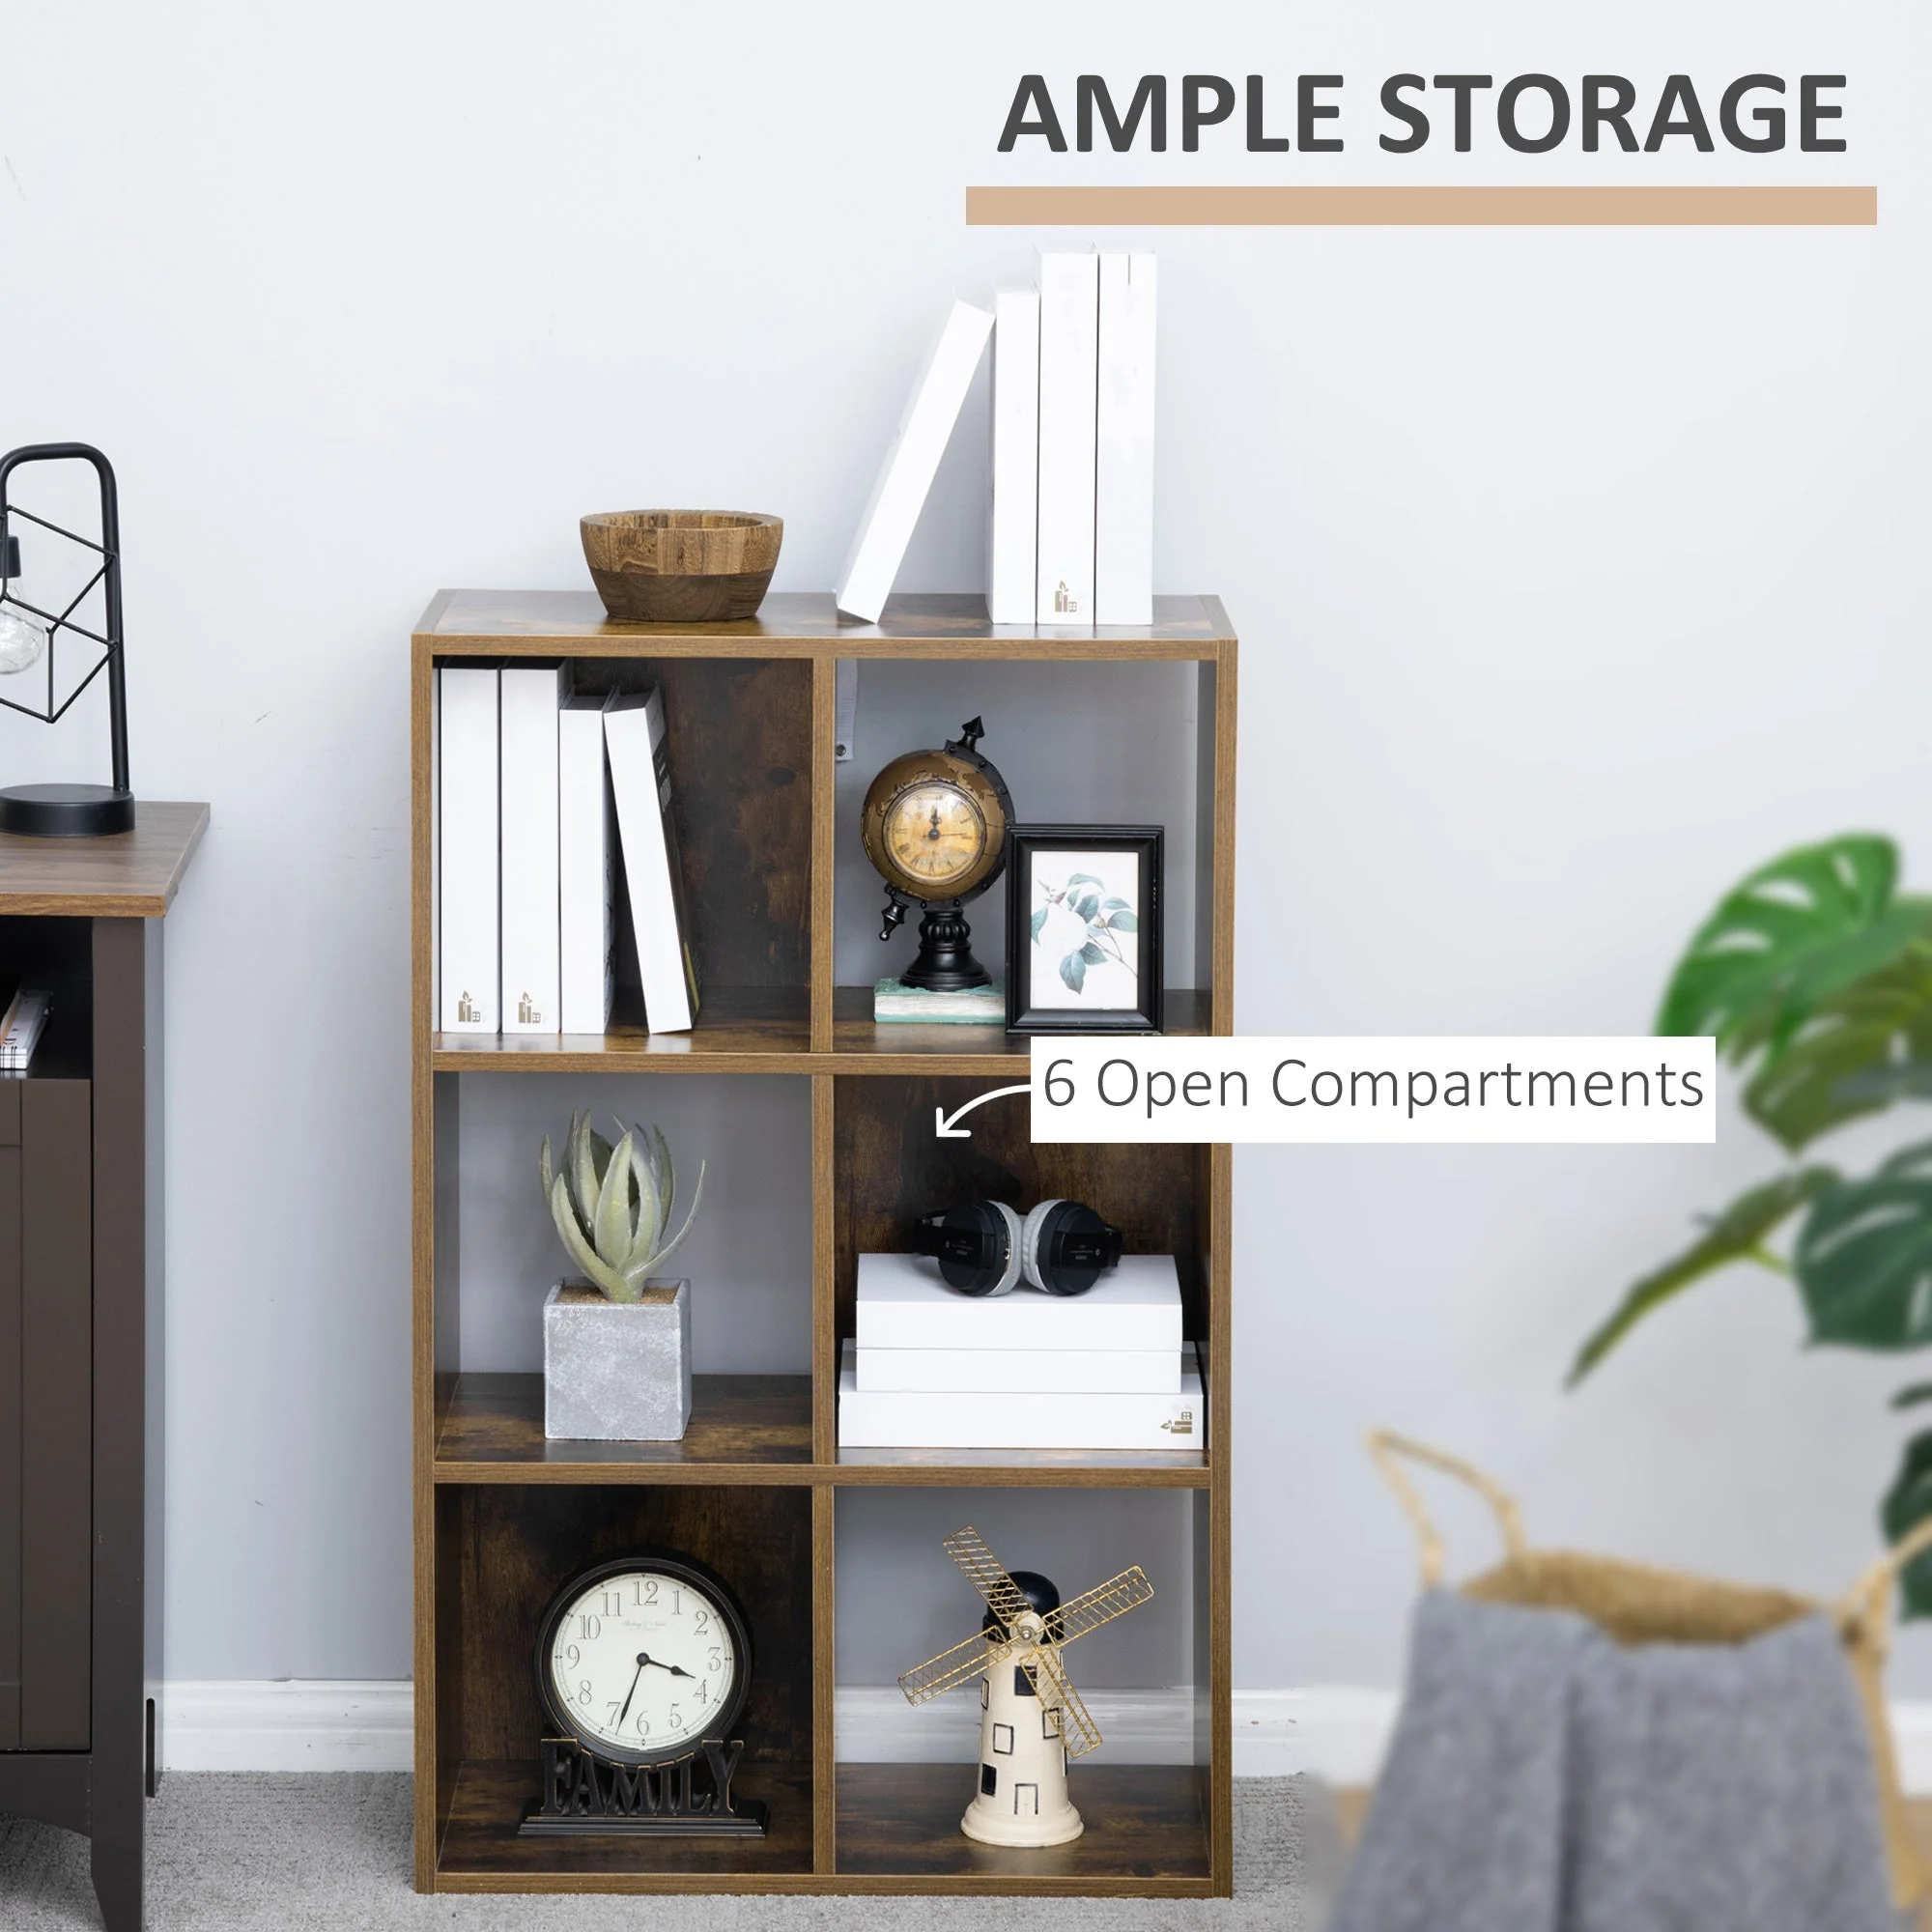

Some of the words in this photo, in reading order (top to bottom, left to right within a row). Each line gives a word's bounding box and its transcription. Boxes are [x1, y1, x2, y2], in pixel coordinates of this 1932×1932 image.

[600, 1591, 622, 1617] 11
[632, 1580, 659, 1606] 12
[671, 1590, 683, 1616] 1
[578, 1614, 601, 1640] 10
[694, 1610, 708, 1635] 2
[566, 1644, 581, 1669] 9
[707, 1647, 722, 1671] 3
[578, 1679, 592, 1705] 8
[693, 1679, 708, 1704] 4
[607, 1702, 621, 1726] 7
[636, 1710, 650, 1735] 6
[668, 1703, 682, 1728] 5
[540, 1738, 745, 1816] FAMILY
